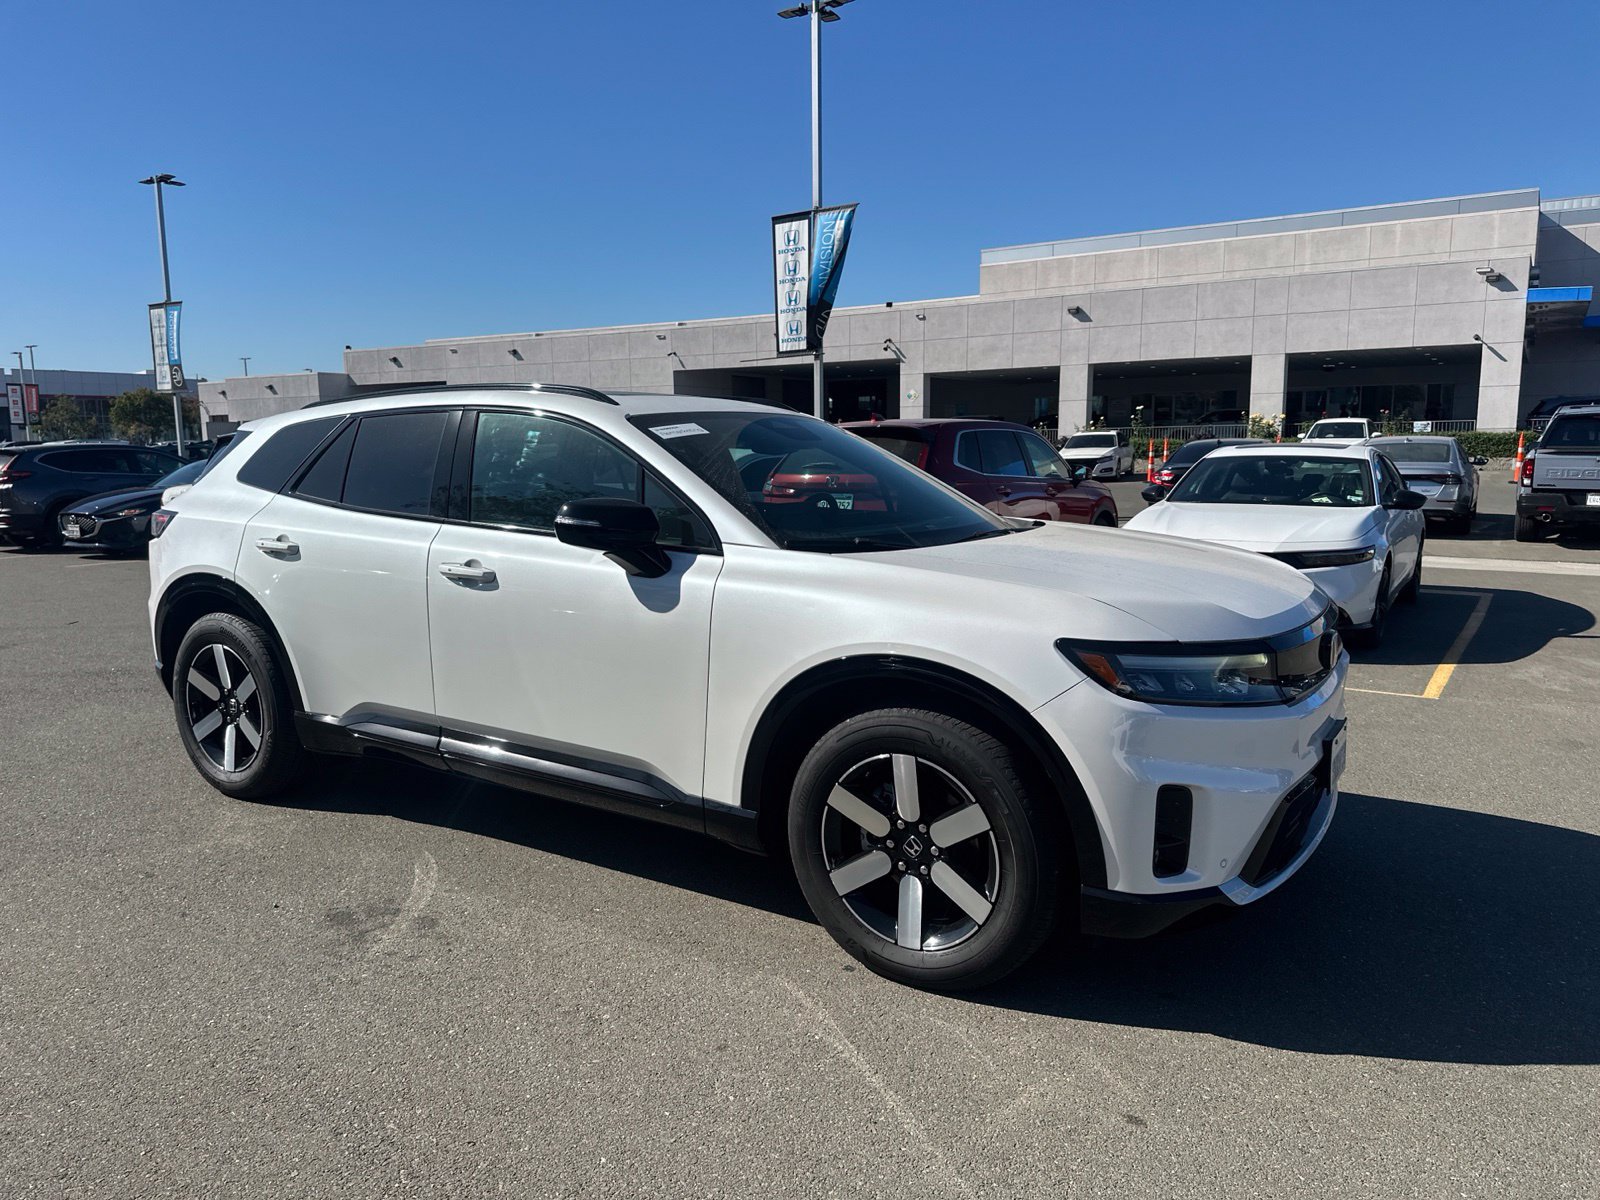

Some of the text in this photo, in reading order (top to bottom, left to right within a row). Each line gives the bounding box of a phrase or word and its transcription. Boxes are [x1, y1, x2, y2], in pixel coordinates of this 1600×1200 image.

[778, 246, 806, 255] HONDA
[779, 276, 806, 285] HONDA
[780, 306, 807, 315] HONDA
